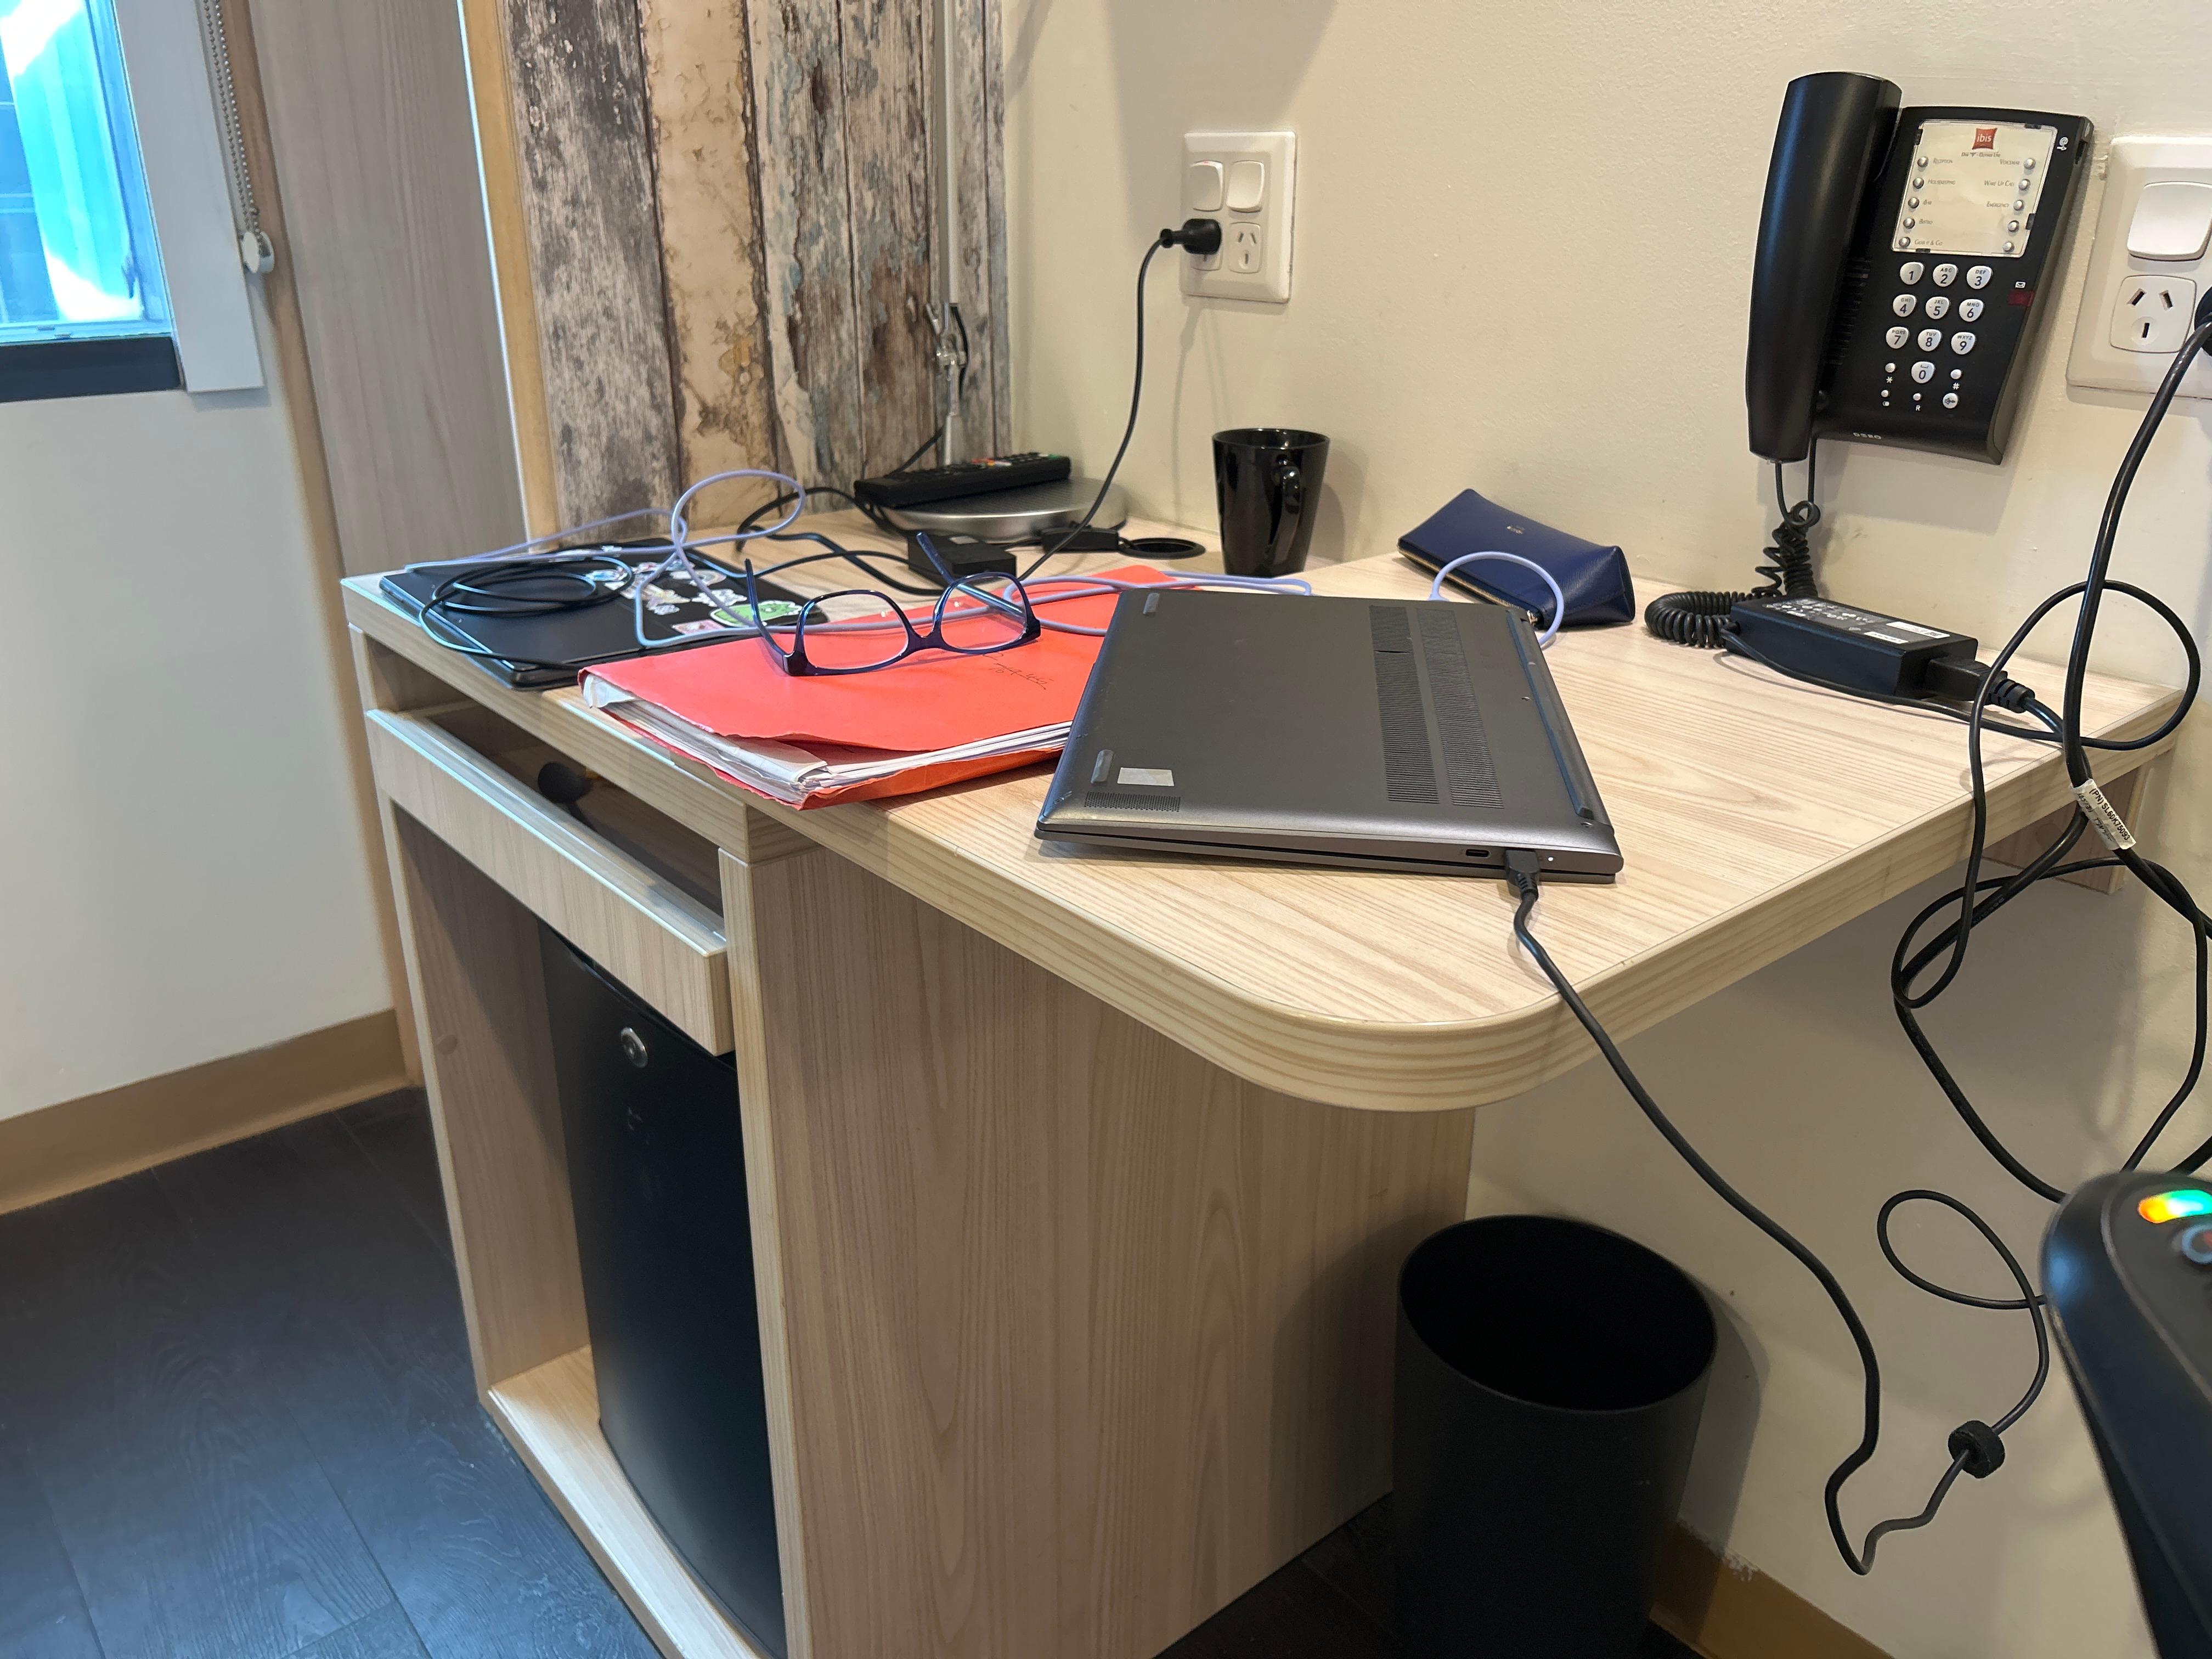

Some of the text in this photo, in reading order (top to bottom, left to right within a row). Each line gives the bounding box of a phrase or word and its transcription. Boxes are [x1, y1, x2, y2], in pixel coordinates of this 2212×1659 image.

[1977, 134, 1992, 143] ibis
[1909, 271, 1914, 280] 1
[1940, 274, 1948, 284] 2
[1974, 276, 1982, 286] 3
[1900, 304, 1907, 314] 4
[1933, 306, 1941, 316] 5
[1967, 308, 1974, 318] 6
[1894, 335, 1901, 345] 7
[1926, 337, 1932, 347] 8
[1960, 341, 1967, 351] 9
[1918, 370, 1926, 380] 0
[2089, 788, 2103, 805] (PN)
